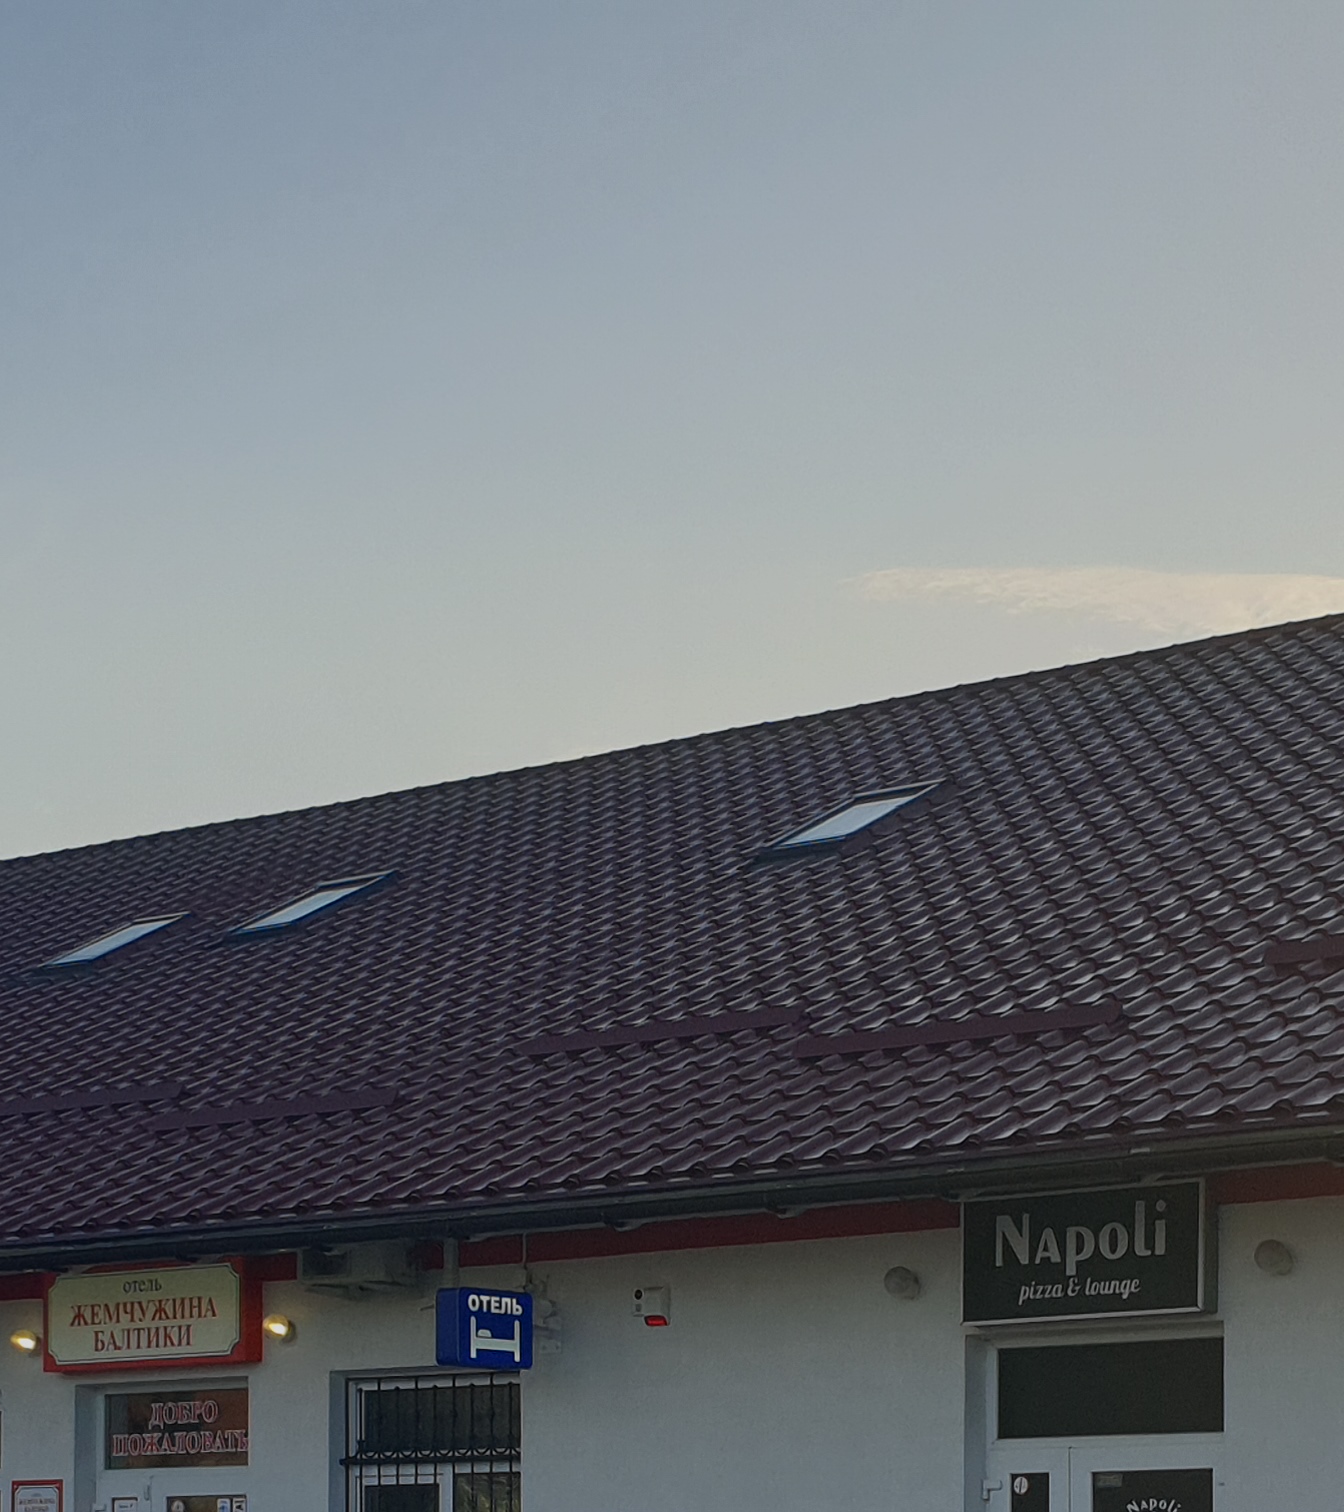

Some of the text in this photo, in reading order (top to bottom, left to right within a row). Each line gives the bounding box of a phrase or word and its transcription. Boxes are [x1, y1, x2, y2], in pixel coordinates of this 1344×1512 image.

[994, 1199, 1167, 1277] Napoli
[467, 1293, 524, 1316] ОТЕЛЬ
[1018, 1277, 1142, 1306] pizza & lounge
[69, 1296, 218, 1327] ЖЕМЧУЖИНА
[93, 1324, 193, 1352] БАЛТИКИ
[148, 1400, 220, 1431] ДОБРО
[112, 1429, 249, 1457] ПОЖАЛОВАТЬ
